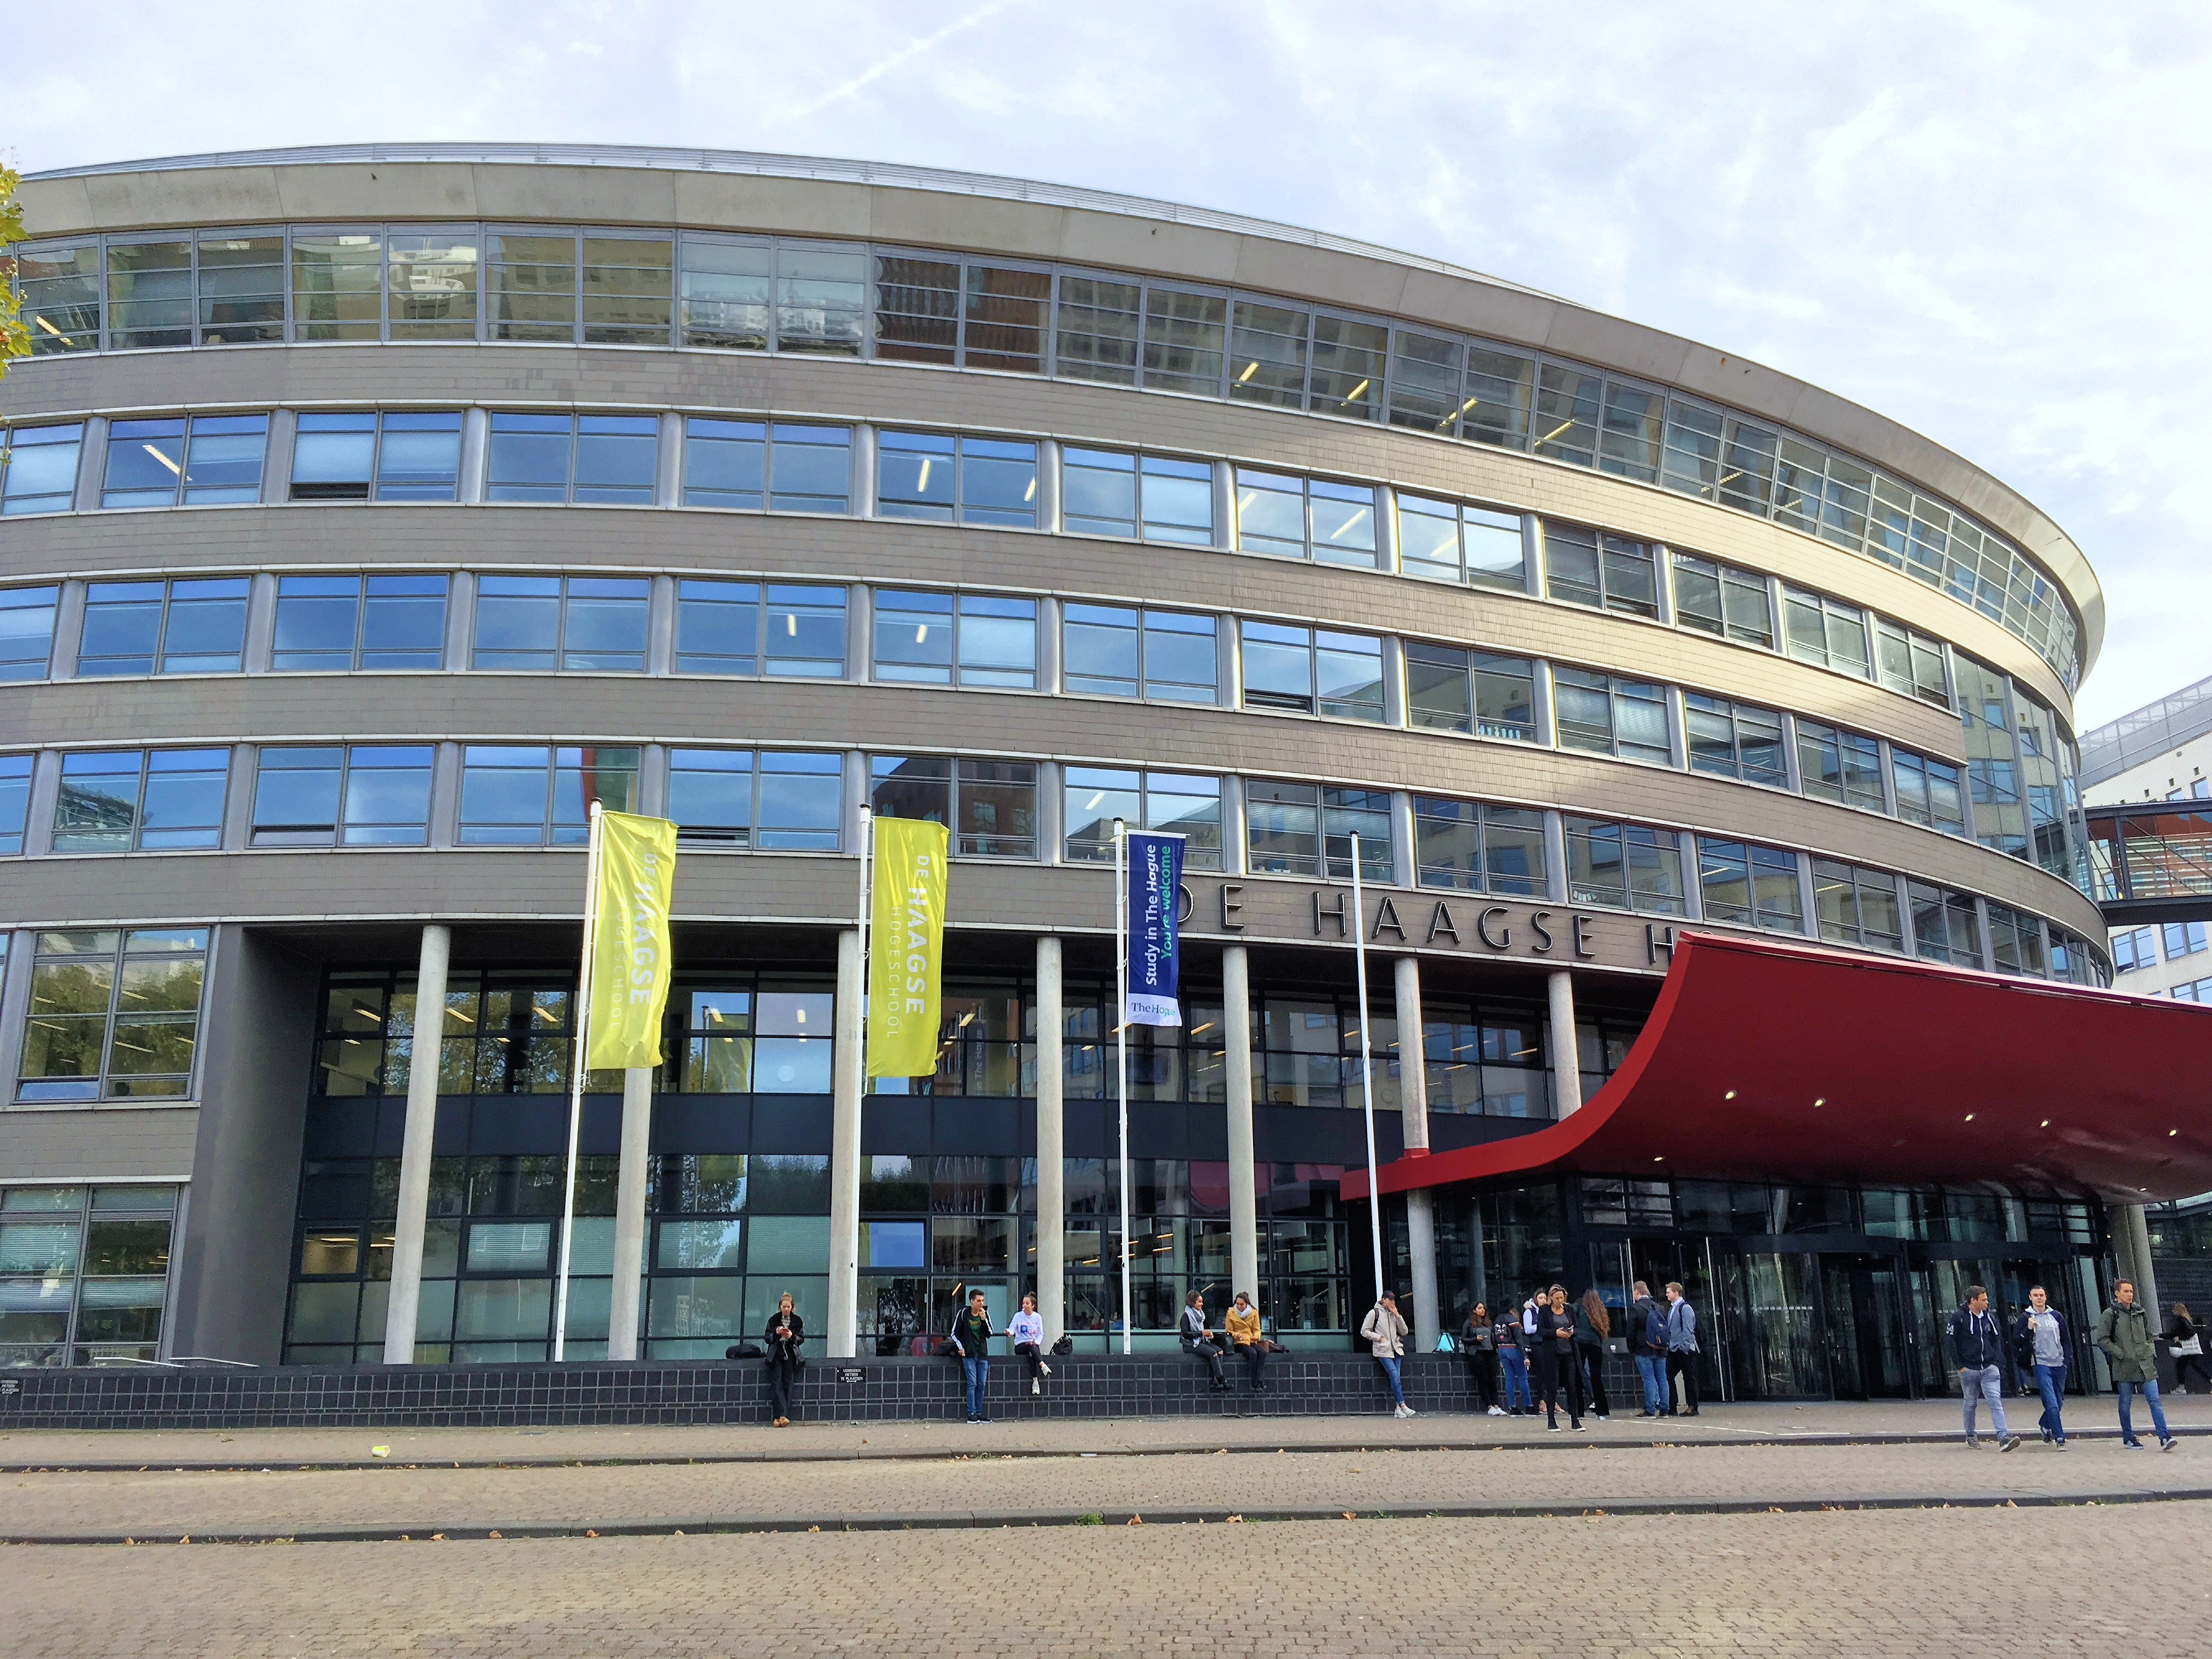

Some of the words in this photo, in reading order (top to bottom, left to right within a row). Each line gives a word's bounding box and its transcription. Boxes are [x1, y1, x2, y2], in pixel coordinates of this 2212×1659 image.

[644, 853, 658, 878] DE
[917, 855, 930, 878] DE
[1146, 844, 1159, 892] Hague
[1159, 845, 1171, 910] welcome
[1145, 895, 1158, 923] The
[1313, 890, 1596, 958] HAAGSE
[630, 883, 657, 1005] HAAGSE
[905, 887, 928, 1015] HAAGSE
[1145, 927, 1157, 940] in
[1160, 915, 1172, 960] You're
[887, 907, 901, 1039] HOGESCHOOL
[1145, 944, 1160, 986] Study
[1131, 1002, 1150, 1013] The
[1152, 1004, 1176, 1017] Hague
